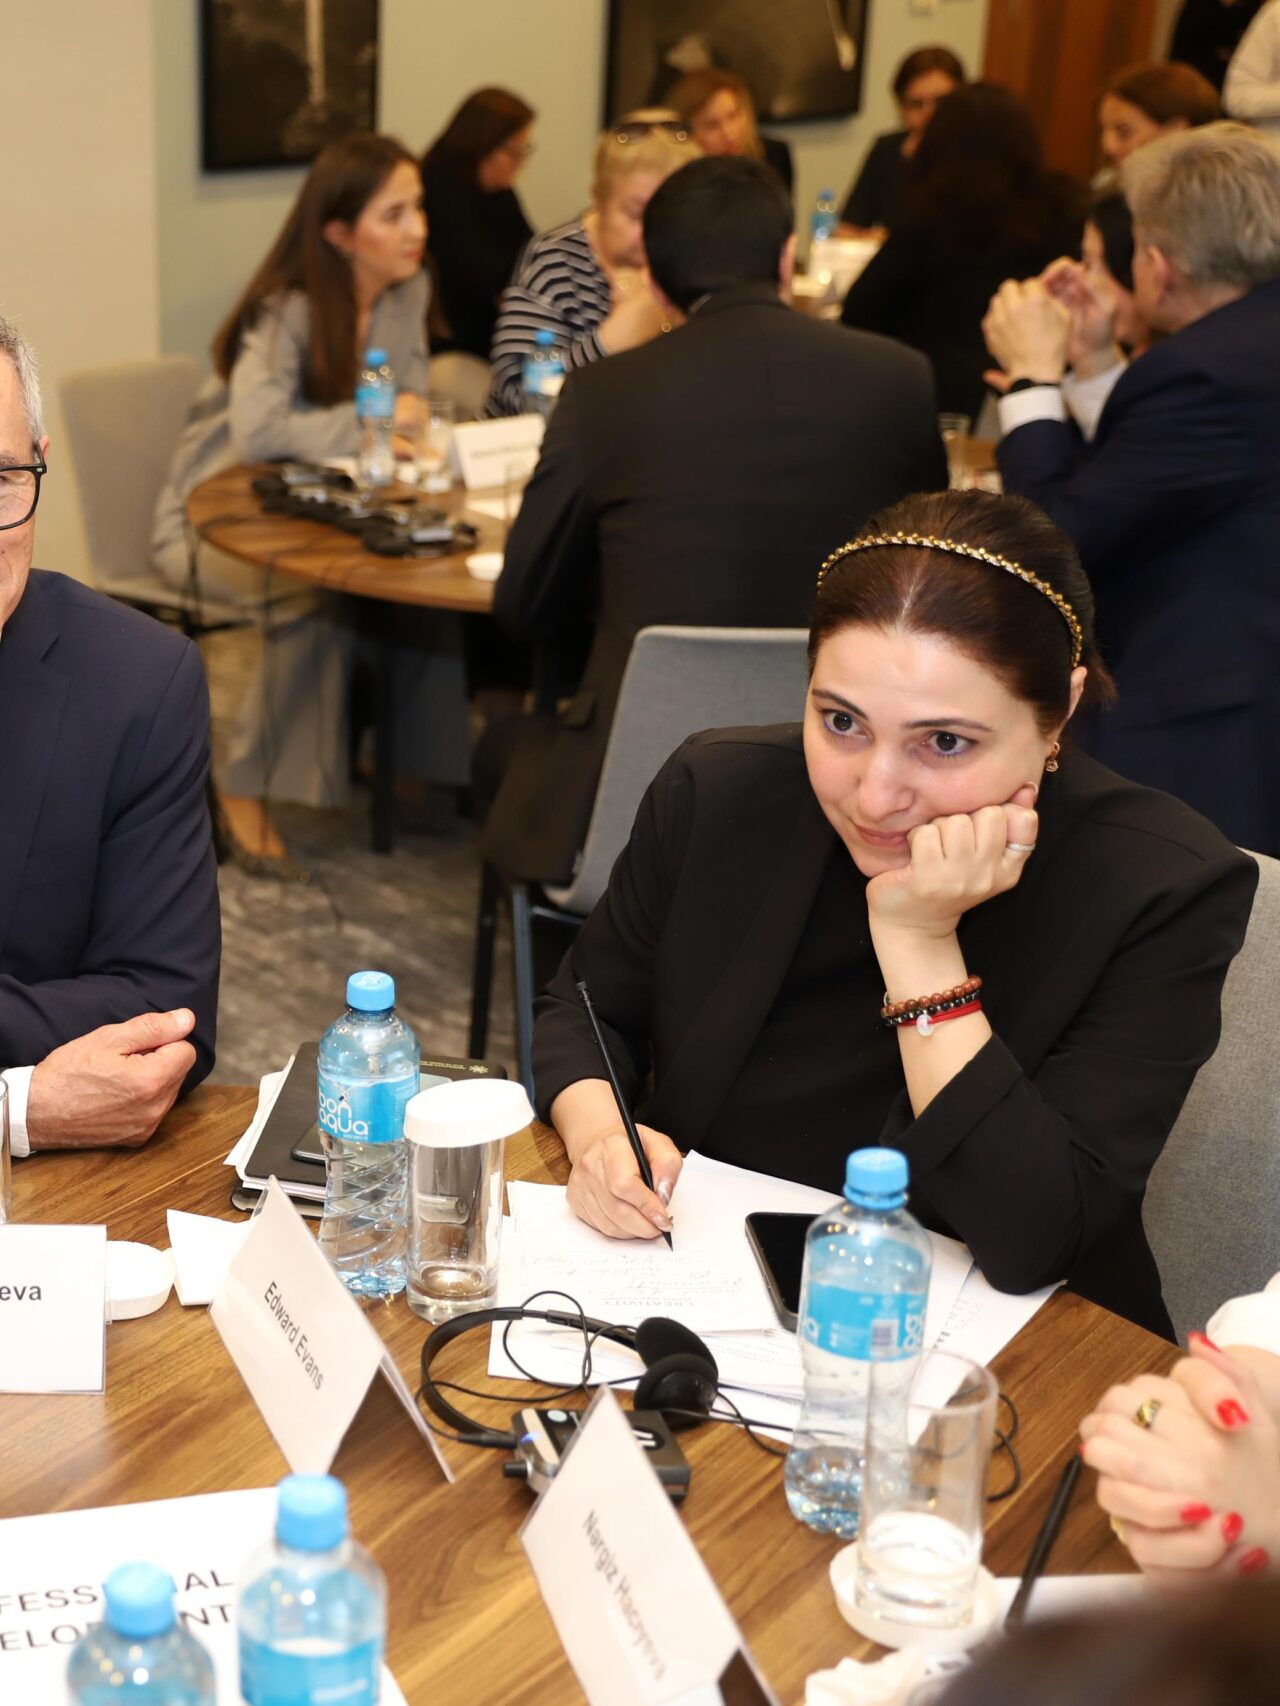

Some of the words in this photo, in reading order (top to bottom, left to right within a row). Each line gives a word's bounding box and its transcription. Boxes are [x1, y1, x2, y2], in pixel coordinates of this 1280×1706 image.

[264, 1281, 301, 1344] Edward
[295, 1334, 324, 1390] Evans
[583, 1509, 619, 1584] Nargiz
